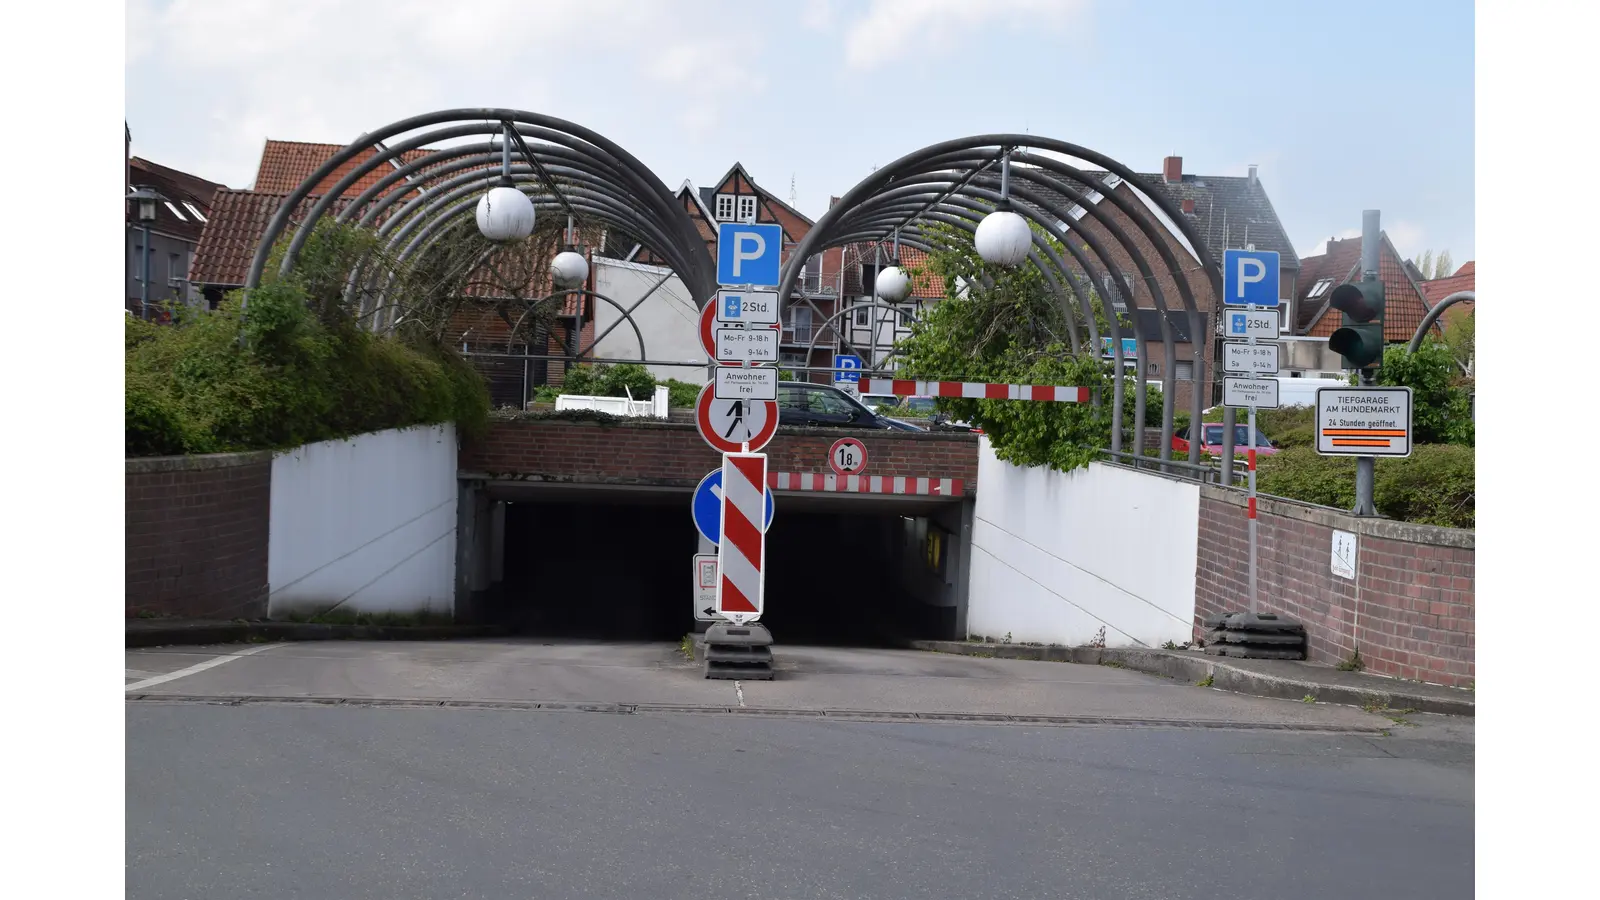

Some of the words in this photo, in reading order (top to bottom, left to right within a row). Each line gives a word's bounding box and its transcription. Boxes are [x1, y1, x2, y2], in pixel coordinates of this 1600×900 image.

[733, 231, 766, 277] P
[1237, 257, 1266, 298] P
[750, 302, 769, 312] Std.
[723, 334, 745, 342] Mo-Fr
[723, 348, 733, 356] Sa
[840, 358, 856, 378] P
[726, 372, 766, 381] Anwohner
[739, 385, 753, 393] frei
[1232, 382, 1269, 391] Anwohner
[1244, 394, 1258, 402] frei
[1337, 396, 1389, 405] TIEFGARAGE
[1325, 405, 1339, 413] AM
[1341, 405, 1401, 414] HUNDEMARKT
[1328, 418, 1337, 426] 24
[1339, 418, 1366, 427] Stunden
[1367, 419, 1397, 429] geöffnet.
